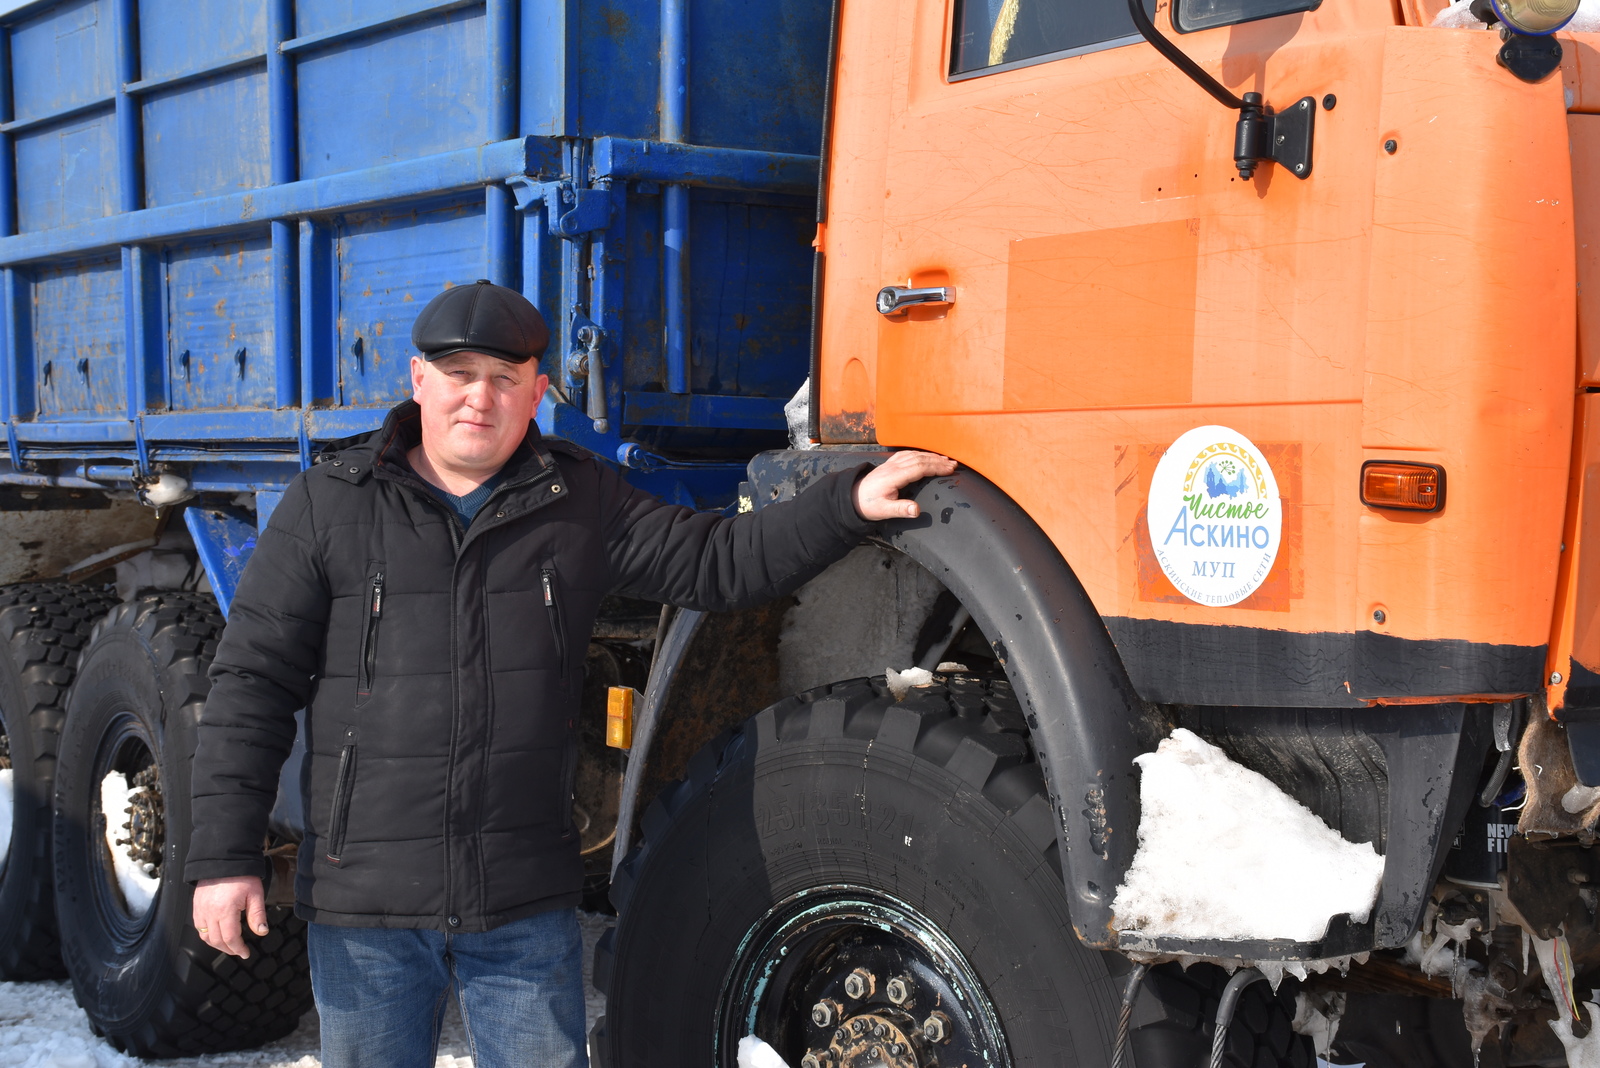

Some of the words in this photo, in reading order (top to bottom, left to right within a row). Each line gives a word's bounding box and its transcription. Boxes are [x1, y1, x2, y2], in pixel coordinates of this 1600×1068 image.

[1183, 493, 1269, 519] Чистое
[1157, 548, 1202, 601] АСКИНСКИЕ
[1205, 582, 1253, 604] ТЕПЛОВЫЕ
[1252, 553, 1271, 583] СЕТИ
[1192, 561, 1235, 578] МУП
[755, 790, 915, 840] 25/85R21
